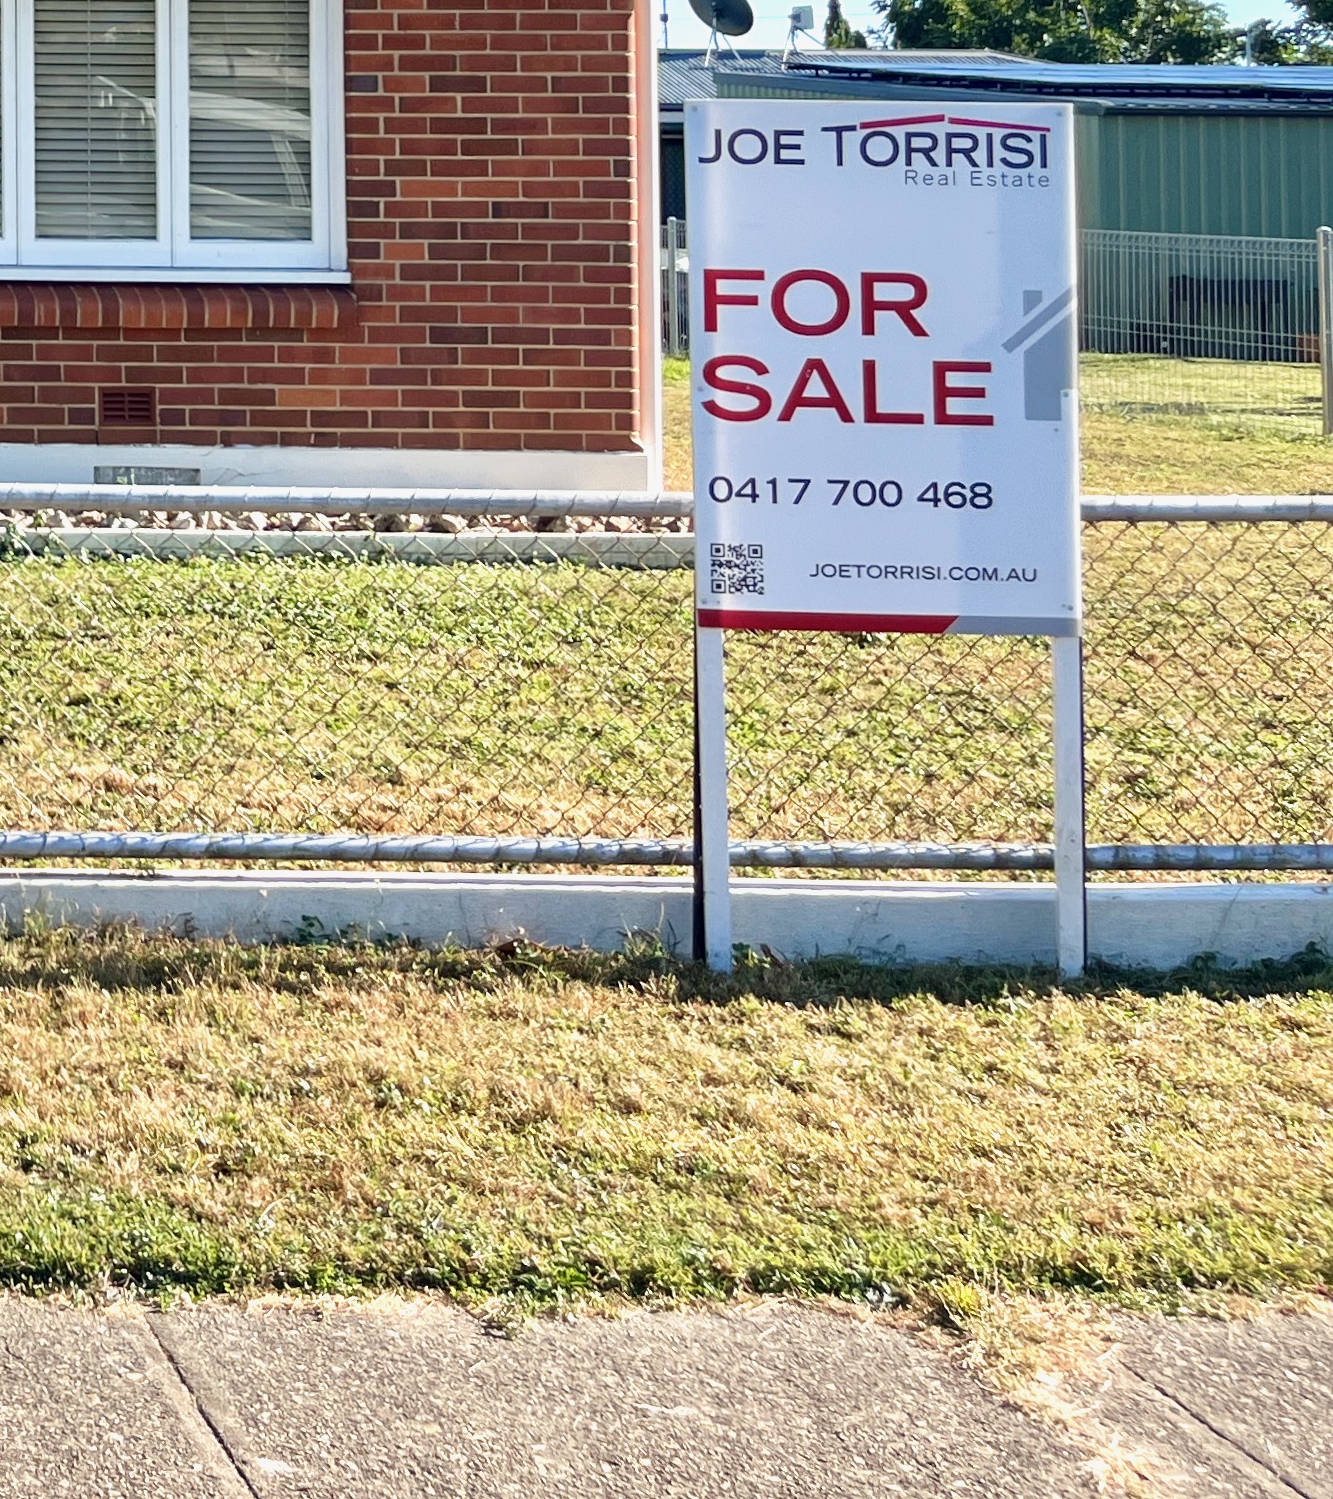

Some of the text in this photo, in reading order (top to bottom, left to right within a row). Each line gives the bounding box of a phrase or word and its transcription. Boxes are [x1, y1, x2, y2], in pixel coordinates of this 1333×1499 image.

[698, 124, 1048, 169] JOE TORRISI
[904, 169, 1050, 187] Real Estate
[703, 269, 930, 337] FOR
[700, 354, 995, 427] SALE
[708, 475, 994, 509] 0417 700 468
[809, 563, 1038, 583] JOETORRISI.COM.AU
